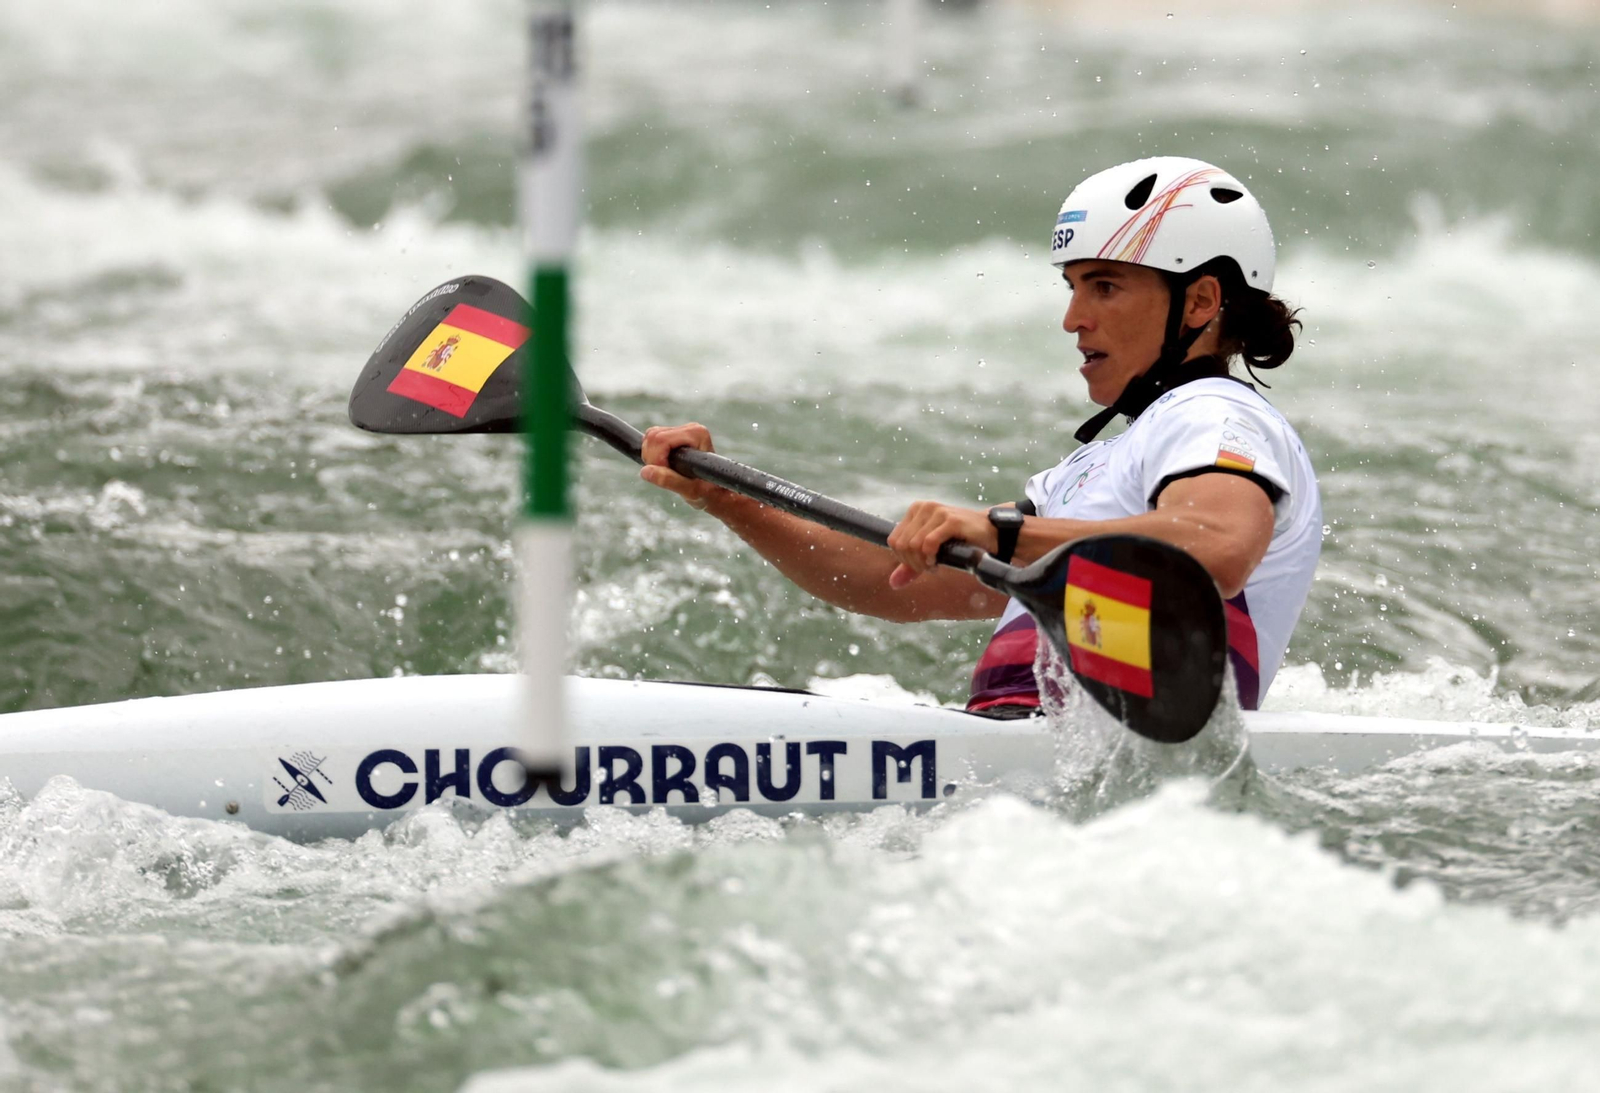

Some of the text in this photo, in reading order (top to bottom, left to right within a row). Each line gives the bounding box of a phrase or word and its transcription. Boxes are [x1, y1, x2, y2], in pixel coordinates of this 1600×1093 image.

[1052, 228, 1075, 251] ESP
[775, 484, 796, 498] PARIS
[355, 739, 957, 809] CHOURRAUT M.
